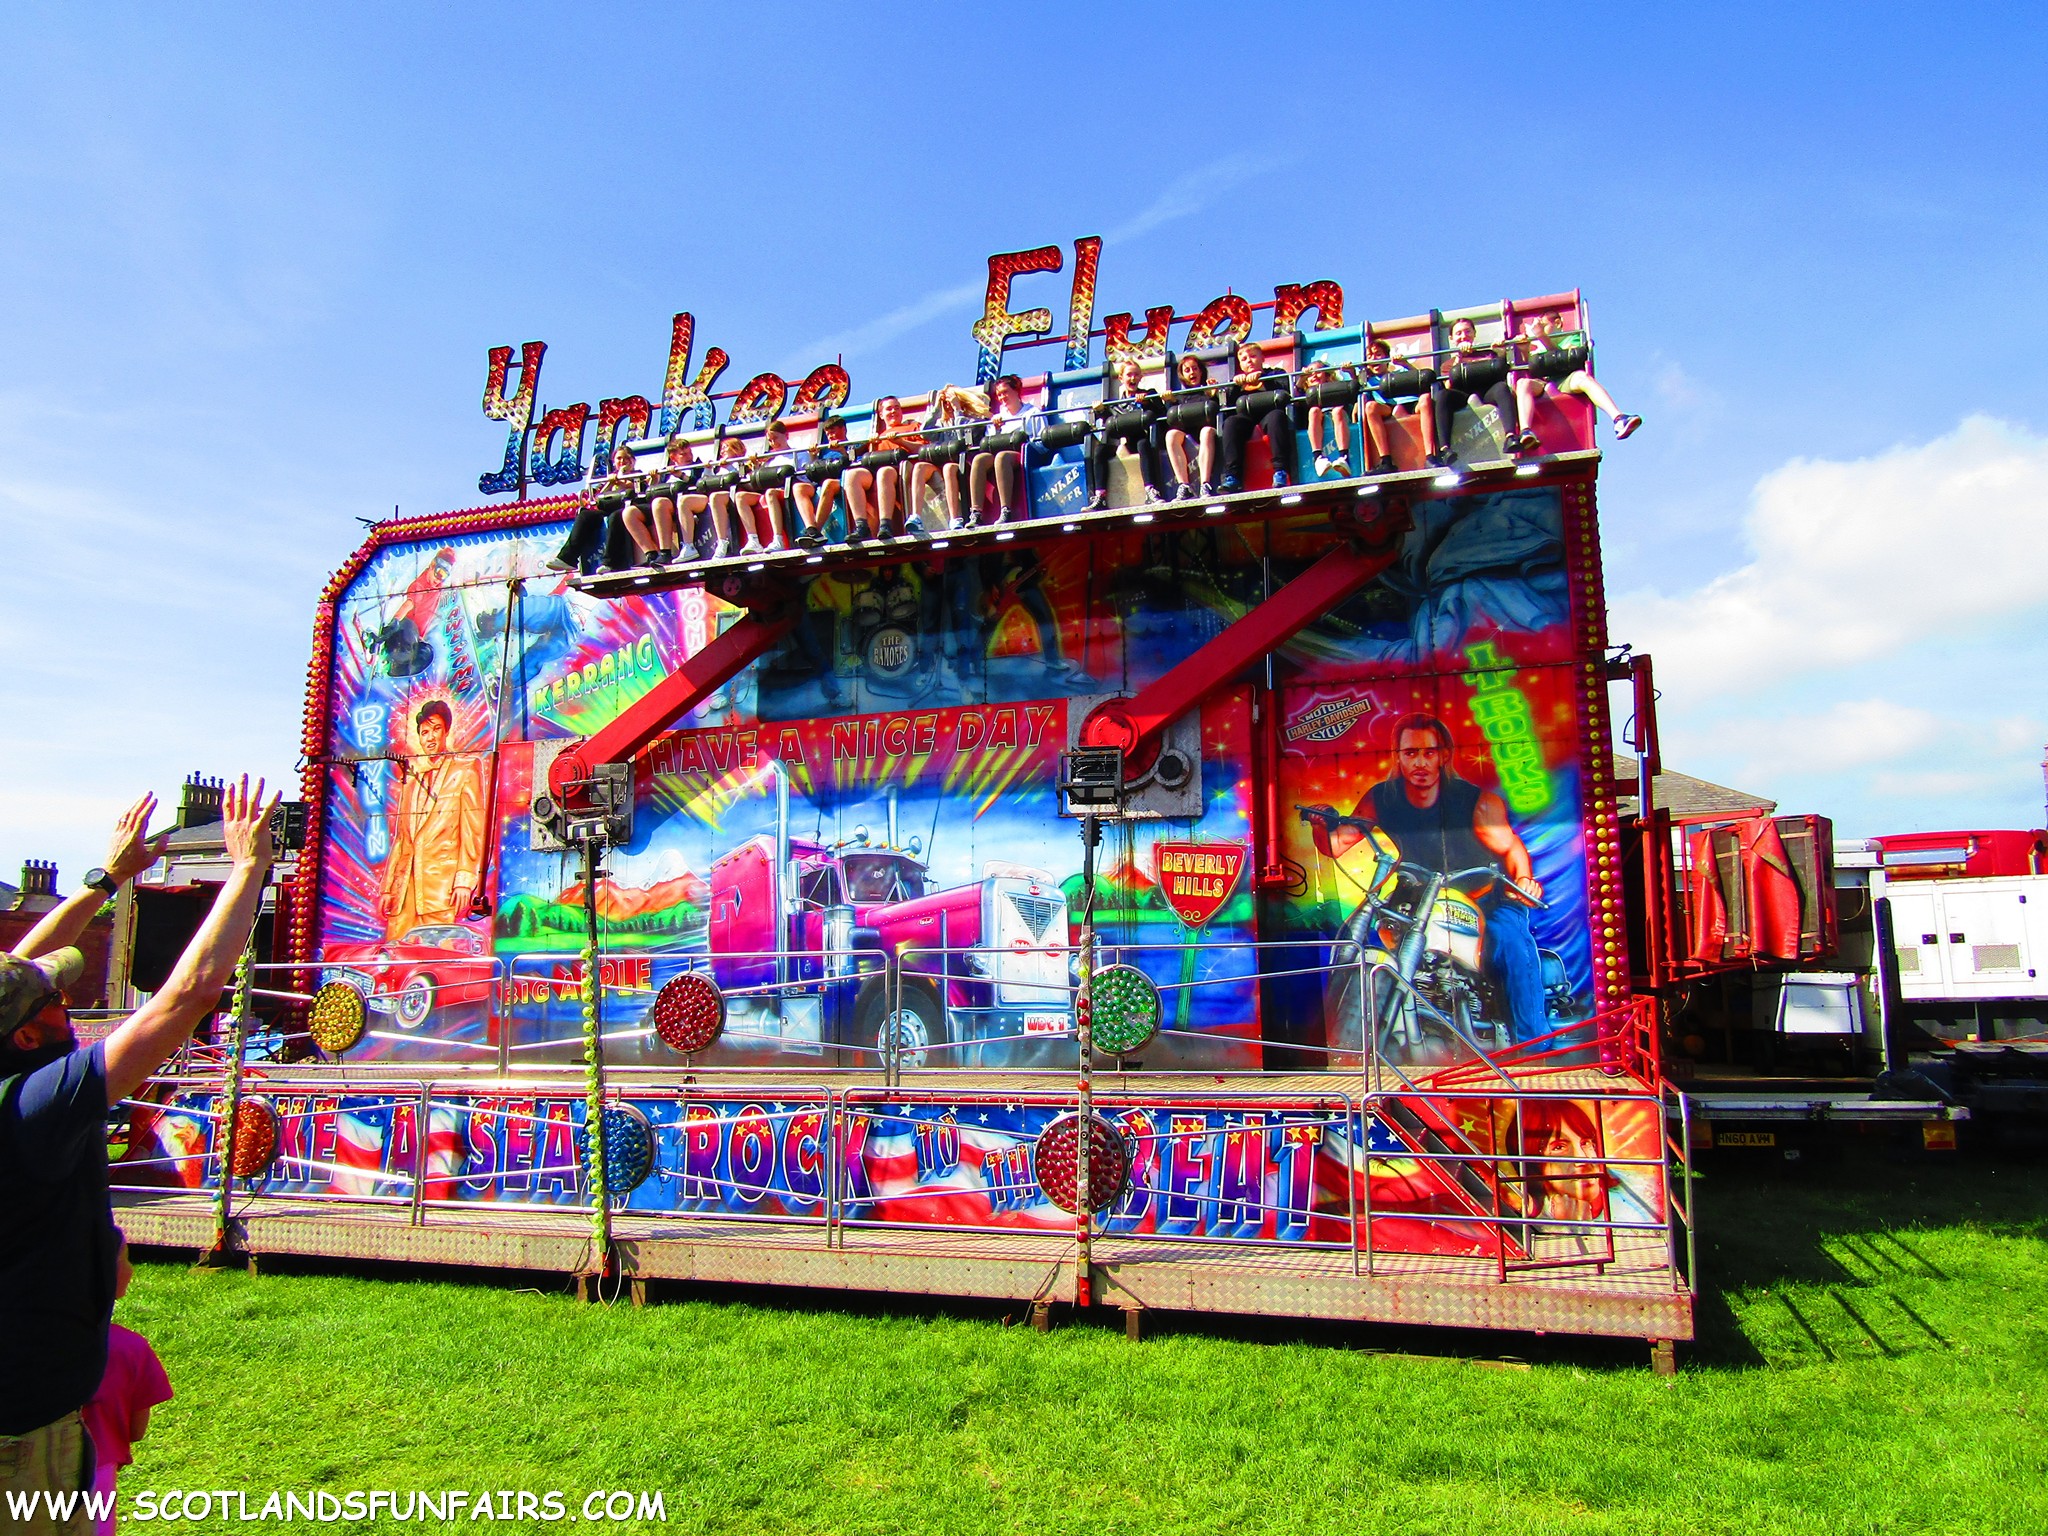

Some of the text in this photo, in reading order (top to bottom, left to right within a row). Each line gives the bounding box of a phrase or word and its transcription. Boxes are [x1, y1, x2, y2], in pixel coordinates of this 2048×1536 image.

[478, 311, 851, 495] Yankee
[882, 636, 901, 646] THE
[873, 645, 909, 667] RAMONES
[535, 633, 654, 714] KERRANG
[1290, 702, 1368, 738] HARLEY-DAVIDSON
[1304, 701, 1346, 721] MOTOR
[647, 705, 1054, 776] HAVE A NICE DAY
[1311, 720, 1352, 739] CYCLES
[1162, 852, 1238, 875] BEVERLY
[1173, 876, 1224, 898] HILLS
[503, 979, 550, 1006] BIG
[1027, 1016, 1065, 1031] WDC 1
[683, 1103, 876, 1207] ROCK
[917, 1112, 961, 1172] TO
[985, 1143, 1043, 1204] TH
